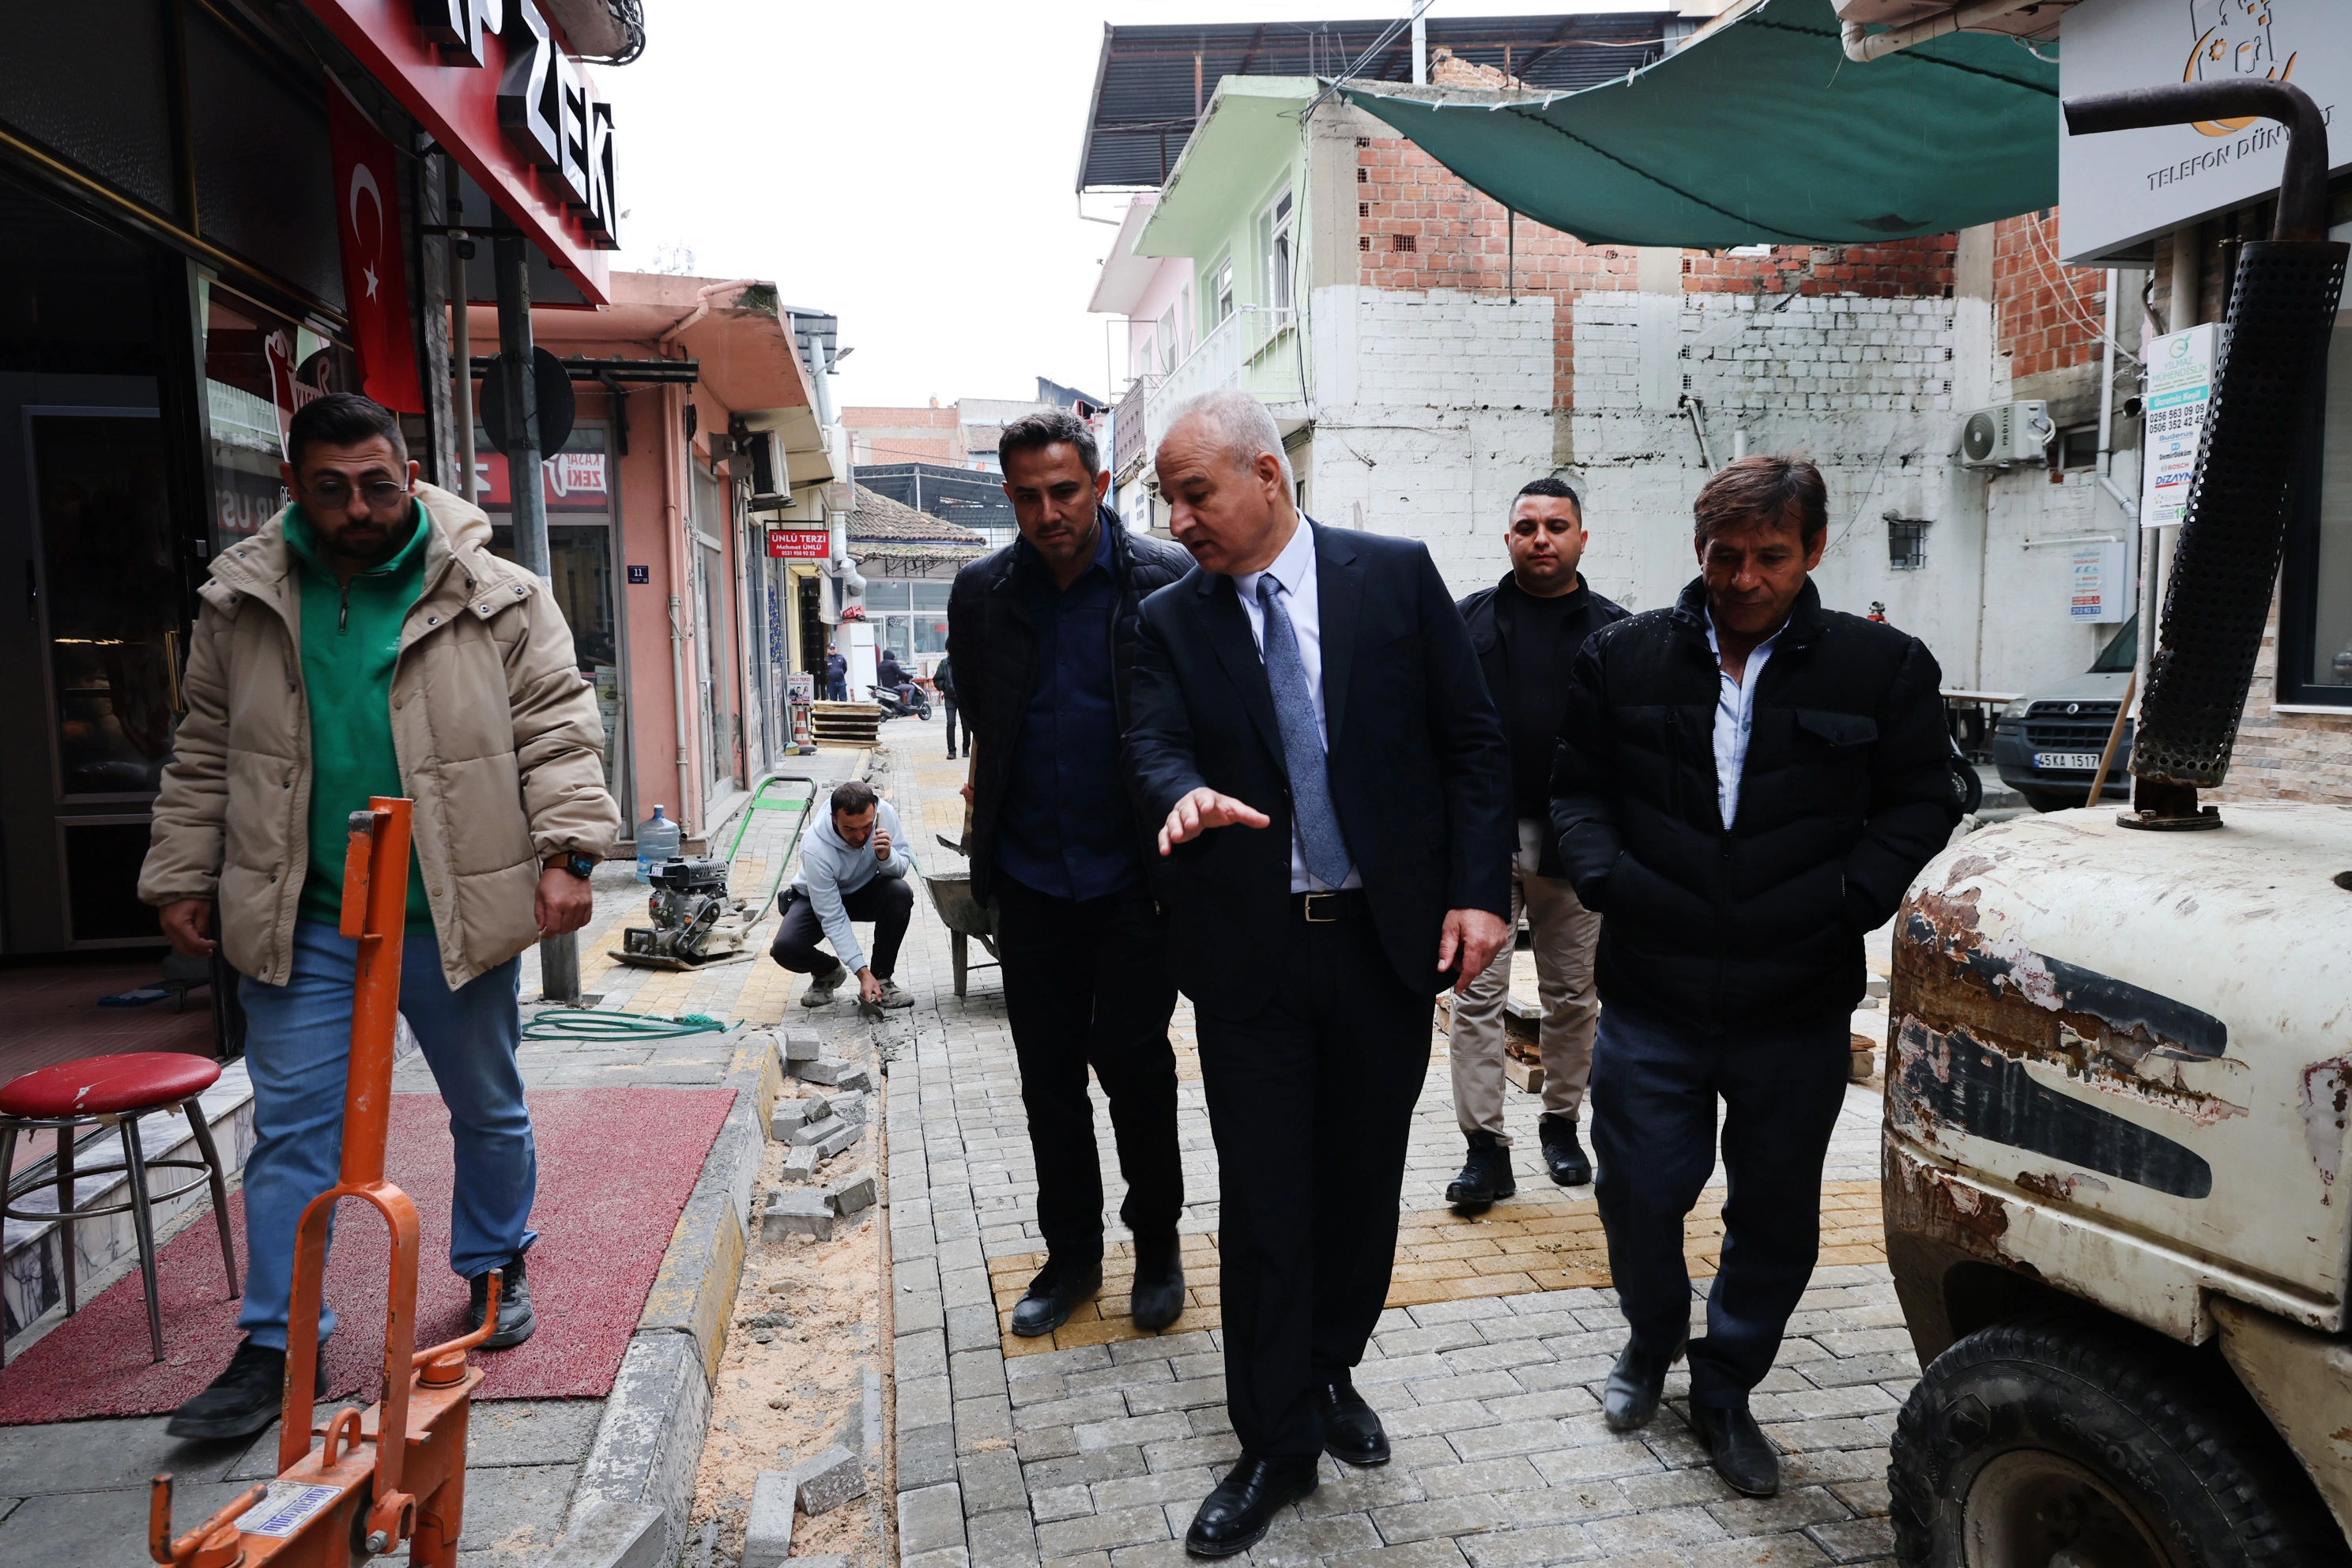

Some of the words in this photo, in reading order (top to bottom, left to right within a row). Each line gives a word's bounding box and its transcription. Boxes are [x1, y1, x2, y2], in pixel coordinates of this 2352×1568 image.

[2147, 145, 2230, 190] TELEFON
[2164, 356, 2194, 370] YILMAZ
[2152, 363, 2207, 383] MÜHENDİSLİK
[2154, 394, 2181, 407] Ücretsiz
[2183, 389, 2202, 401] Keşif
[2150, 411, 2166, 423] 0256
[2169, 408, 2181, 419] 563
[2184, 405, 2193, 416] 09
[2196, 404, 2204, 414] 09
[2149, 422, 2166, 433] 0506
[2168, 419, 2181, 430] 352
[2184, 416, 2192, 427] 42
[2195, 415, 2204, 424] 45
[2159, 431, 2194, 441] Buderus
[2159, 450, 2192, 460] DemirDöküm
[2175, 507, 2187, 518] 18
[772, 533, 797, 542] ÜNLÜ
[800, 533, 826, 543] TERZİ
[634, 568, 643, 577] 11
[2038, 755, 2051, 766] 45
[2053, 755, 2066, 767] KA
[2071, 756, 2097, 767] 1517
